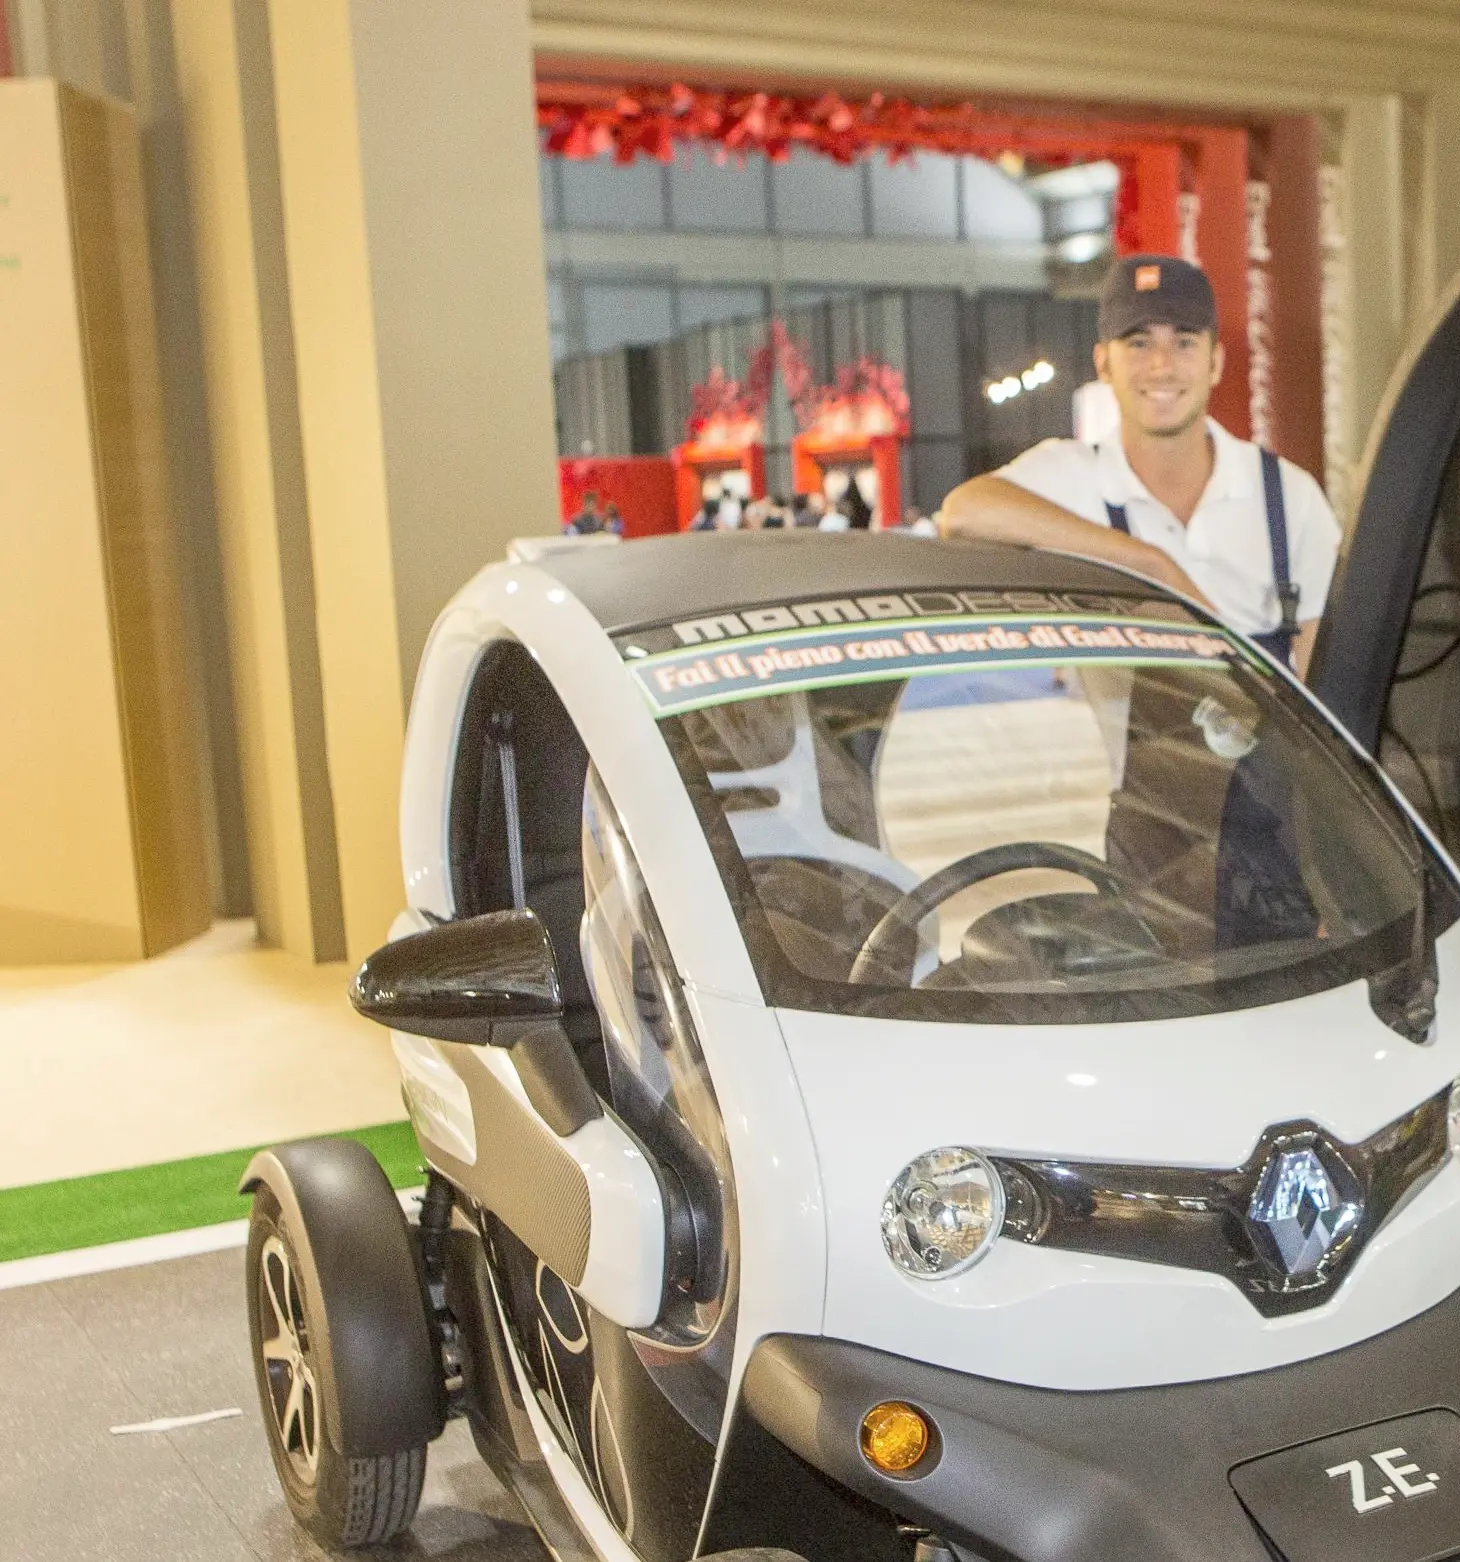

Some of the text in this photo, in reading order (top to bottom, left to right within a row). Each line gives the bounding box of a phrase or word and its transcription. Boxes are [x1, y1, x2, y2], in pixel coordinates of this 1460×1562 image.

[654, 658, 719, 692] Fai
[712, 651, 750, 679] il
[748, 645, 844, 680] pieno
[844, 637, 908, 661] con
[901, 629, 941, 656] il
[934, 625, 1030, 655] verde
[1027, 623, 1068, 648] di
[1059, 623, 1135, 648] Enel
[1325, 1447, 1440, 1514] Z.E.
